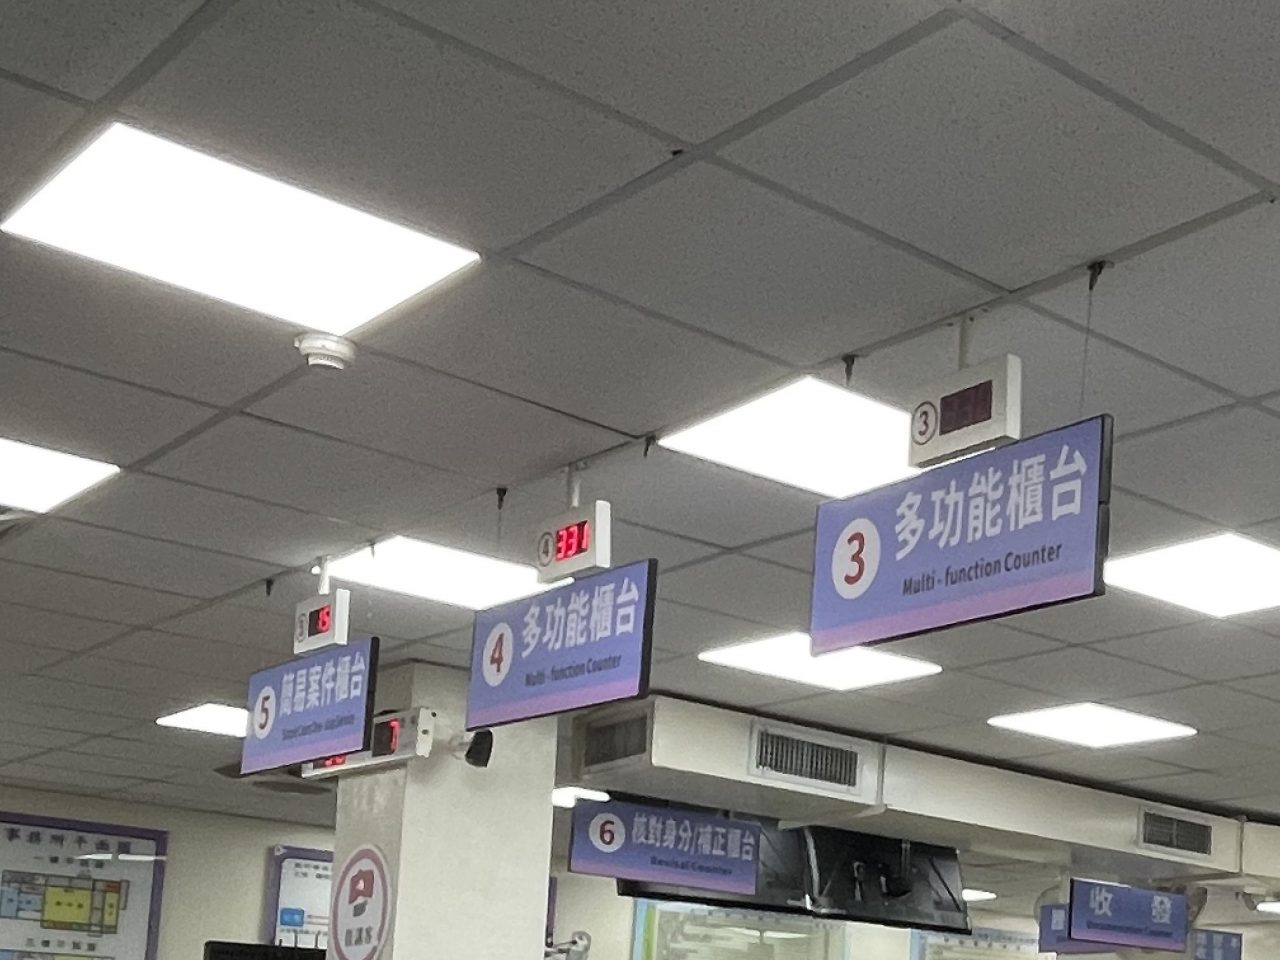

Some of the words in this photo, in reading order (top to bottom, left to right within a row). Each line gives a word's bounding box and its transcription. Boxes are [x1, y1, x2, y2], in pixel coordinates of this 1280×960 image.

[918, 410, 929, 436] 3
[895, 444, 1087, 561] 多功能櫃台
[555, 523, 590, 560] 331
[844, 532, 865, 585] 3
[1003, 543, 1062, 570] Counter
[521, 577, 640, 658] 多功能櫃台
[490, 632, 504, 673] 4
[258, 695, 271, 730] 5
[599, 820, 615, 845] 6
